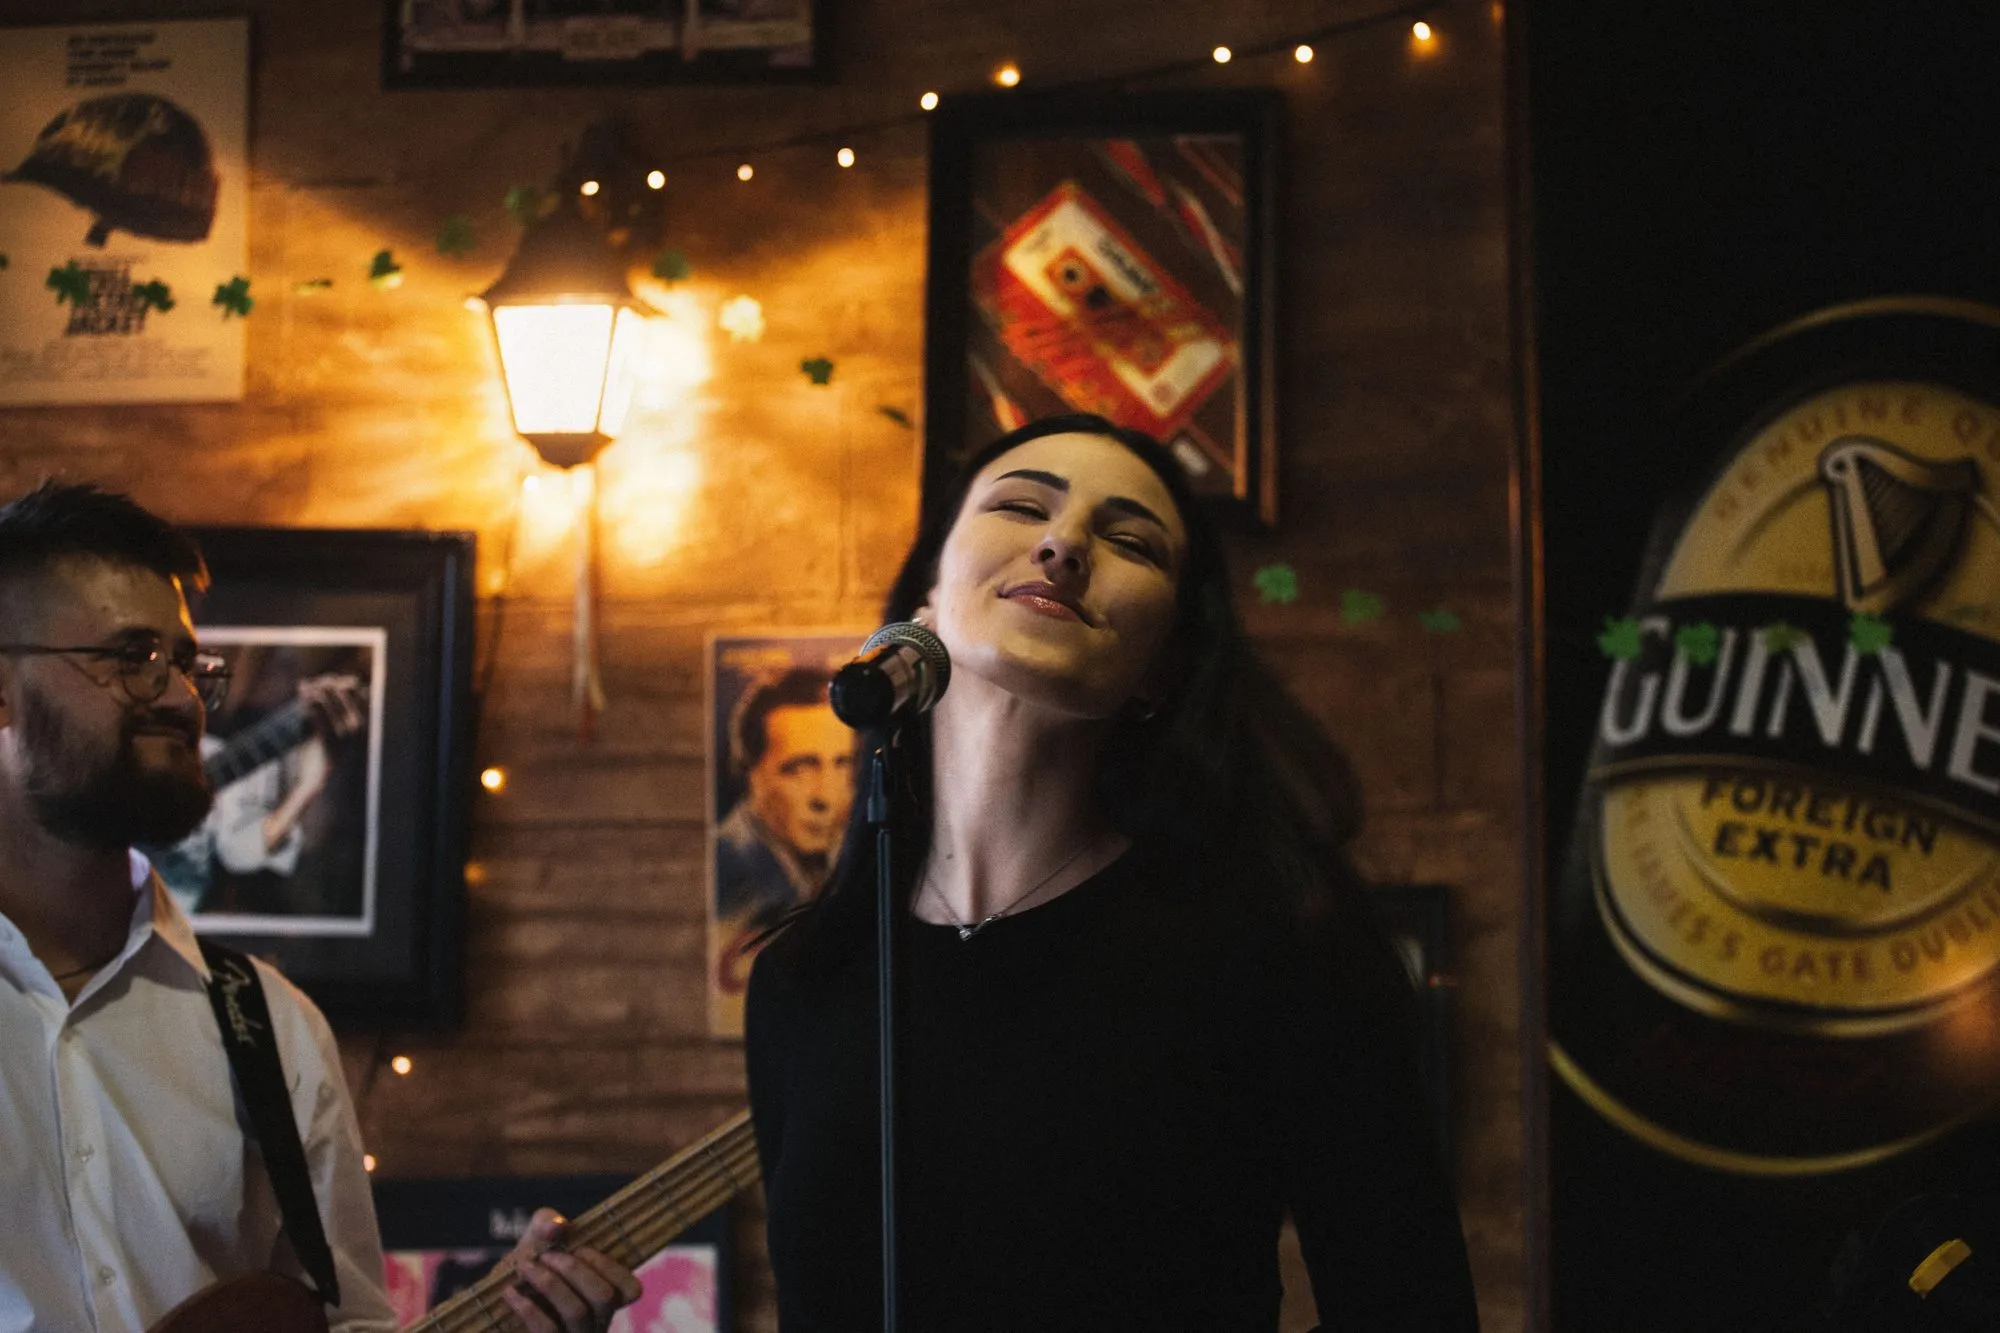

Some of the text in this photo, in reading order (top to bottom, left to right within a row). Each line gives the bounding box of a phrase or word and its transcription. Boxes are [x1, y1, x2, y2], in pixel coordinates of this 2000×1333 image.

[1715, 394, 1922, 519] GENUINE
[1702, 775, 1938, 854] FOREIGN
[1714, 821, 1890, 891] EXTRA
[1760, 946, 1870, 981] GATE
[1890, 880, 2000, 974] DUBLI
